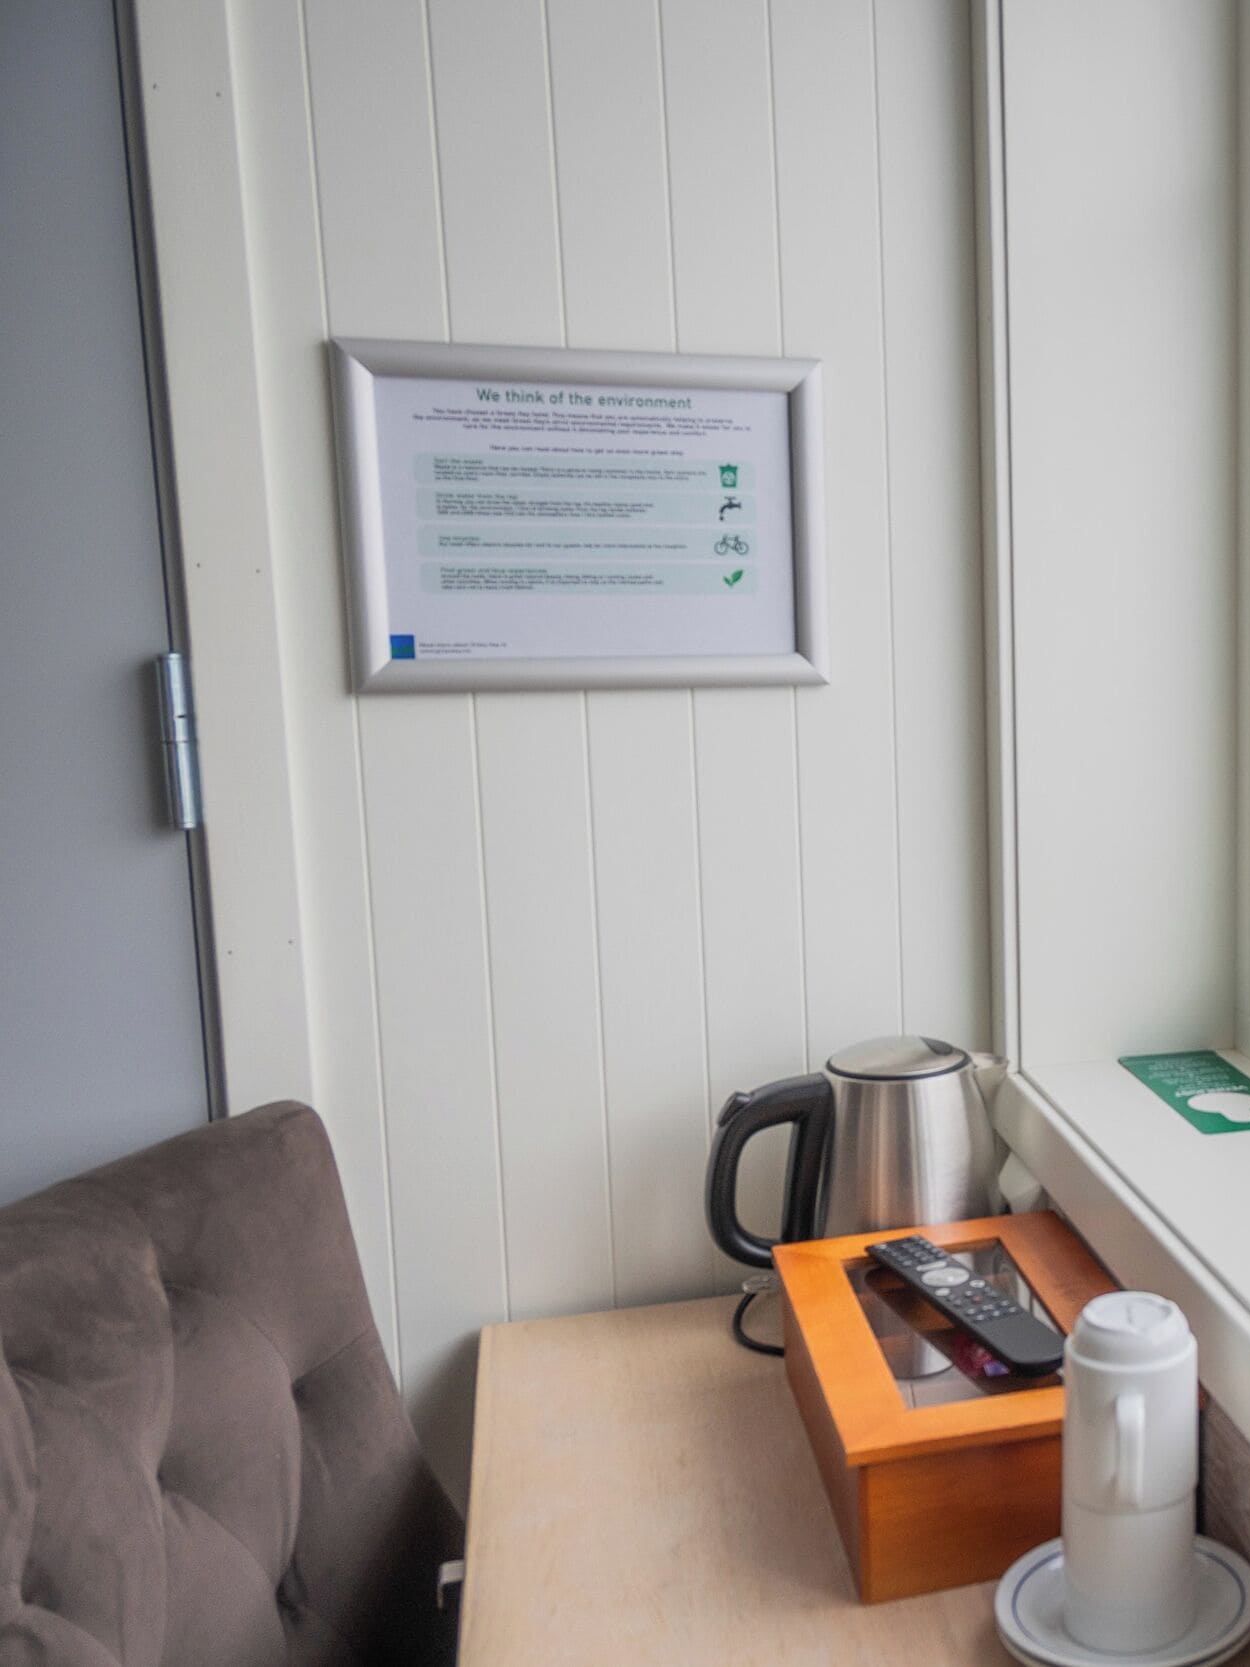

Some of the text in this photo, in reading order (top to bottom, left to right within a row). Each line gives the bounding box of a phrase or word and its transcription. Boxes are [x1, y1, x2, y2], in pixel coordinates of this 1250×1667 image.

[476, 387, 692, 409] We think of the environment
